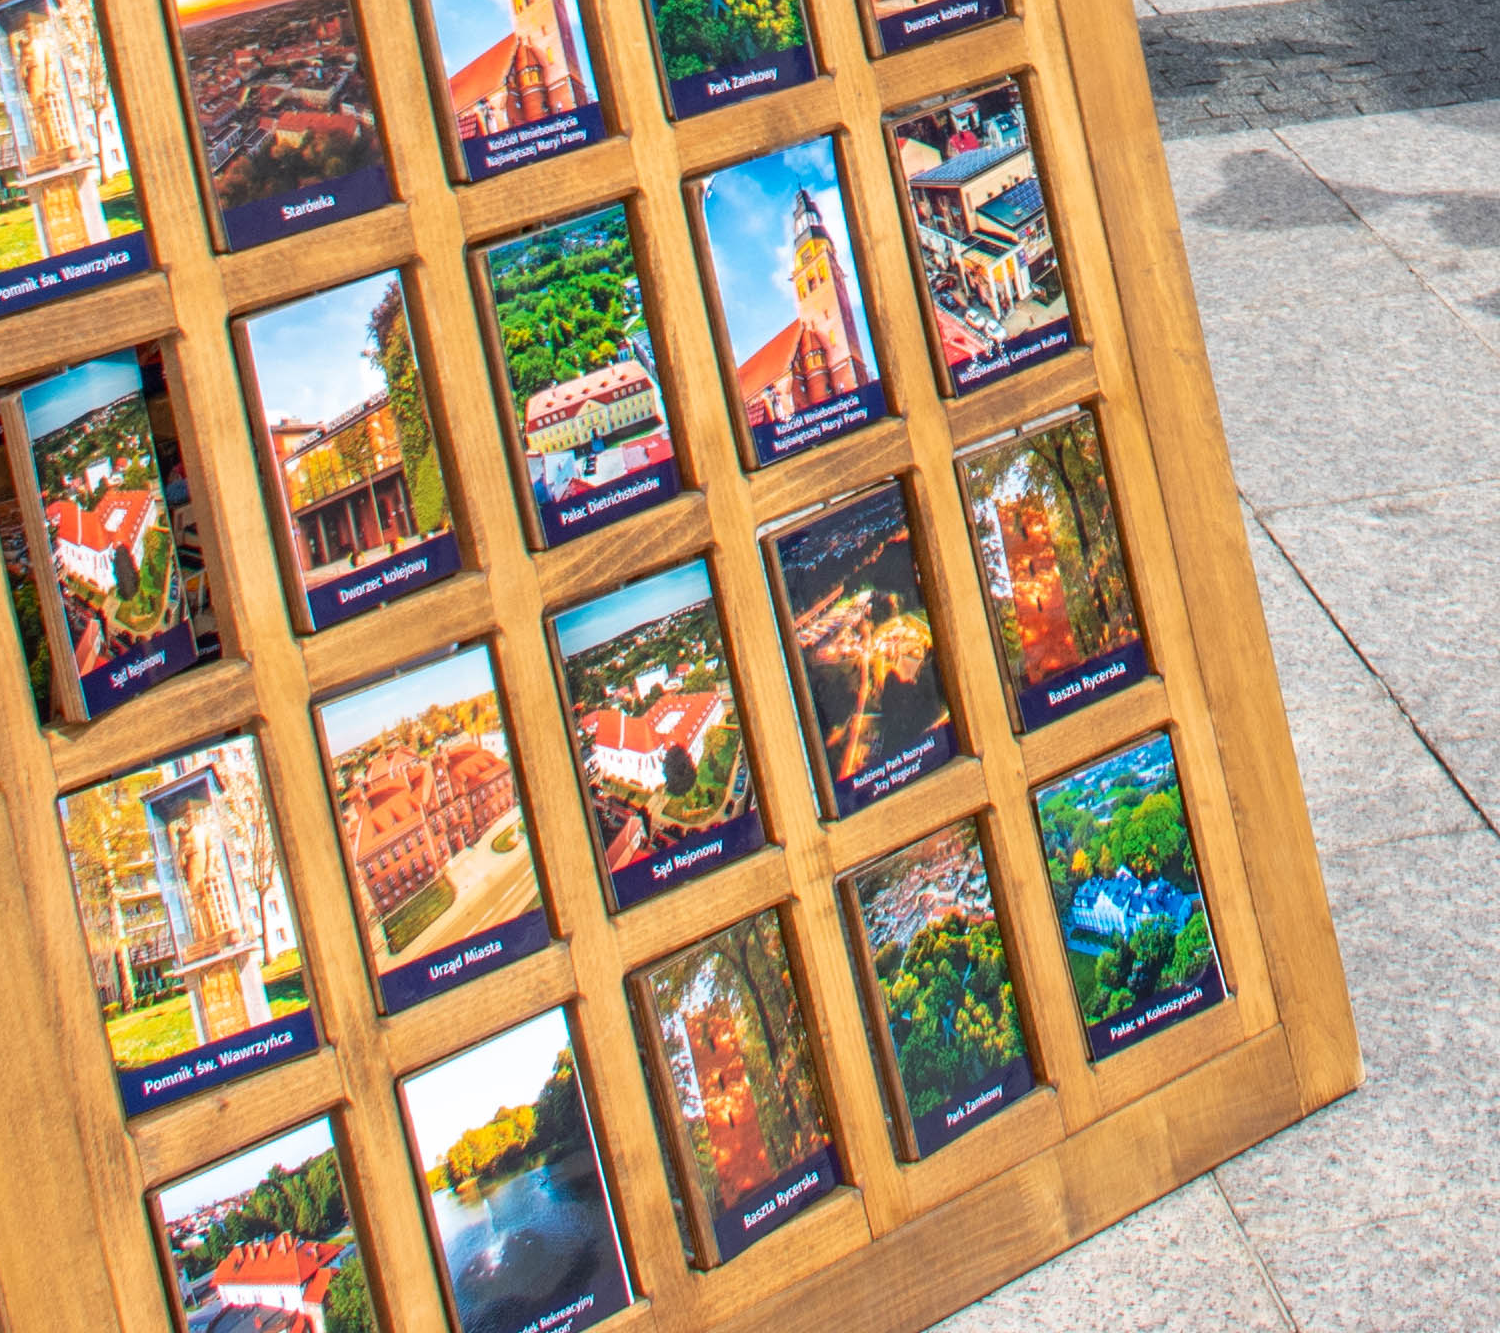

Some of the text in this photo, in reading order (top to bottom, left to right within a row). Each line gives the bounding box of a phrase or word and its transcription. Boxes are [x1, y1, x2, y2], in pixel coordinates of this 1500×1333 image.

[903, 0, 979, 34] Dworzec kolejowy
[707, 67, 778, 96] Park Zamkowy
[487, 114, 579, 151] Kościół Wniebowzięcia
[537, 135, 561, 152] Maryi
[560, 128, 587, 145] Panny
[281, 194, 336, 221] Starówka
[40, 272, 61, 290] św.
[60, 250, 132, 282] Wawrzyńca
[1009, 341, 1042, 363] Centrum
[1041, 331, 1068, 350] Kultury
[774, 393, 860, 437] Kościół Wniebowzięcia
[821, 415, 844, 434] Maryi
[843, 407, 869, 425] Panny
[560, 476, 661, 527] Pałac Dietrichsteinów
[338, 557, 428, 605] Dworzec kolejowy
[109, 649, 167, 689] Sąd Rejonowy
[1047, 660, 1127, 707] Baszta Rycerska
[885, 754, 903, 773] Park
[902, 735, 935, 763] Rozrywki
[652, 838, 723, 879] Sąd Rejonowy
[429, 940, 503, 981] Urząd Miasta
[1109, 1016, 1137, 1042] Pałac
[1145, 986, 1203, 1024] Kokoszycach
[143, 1029, 294, 1096] Pomnik św. Wawrzyńca
[945, 1083, 1003, 1129] Park Zamkowy
[742, 1170, 819, 1231] Baszta Rycerska
[539, 1292, 595, 1330] Rekreacyjny
